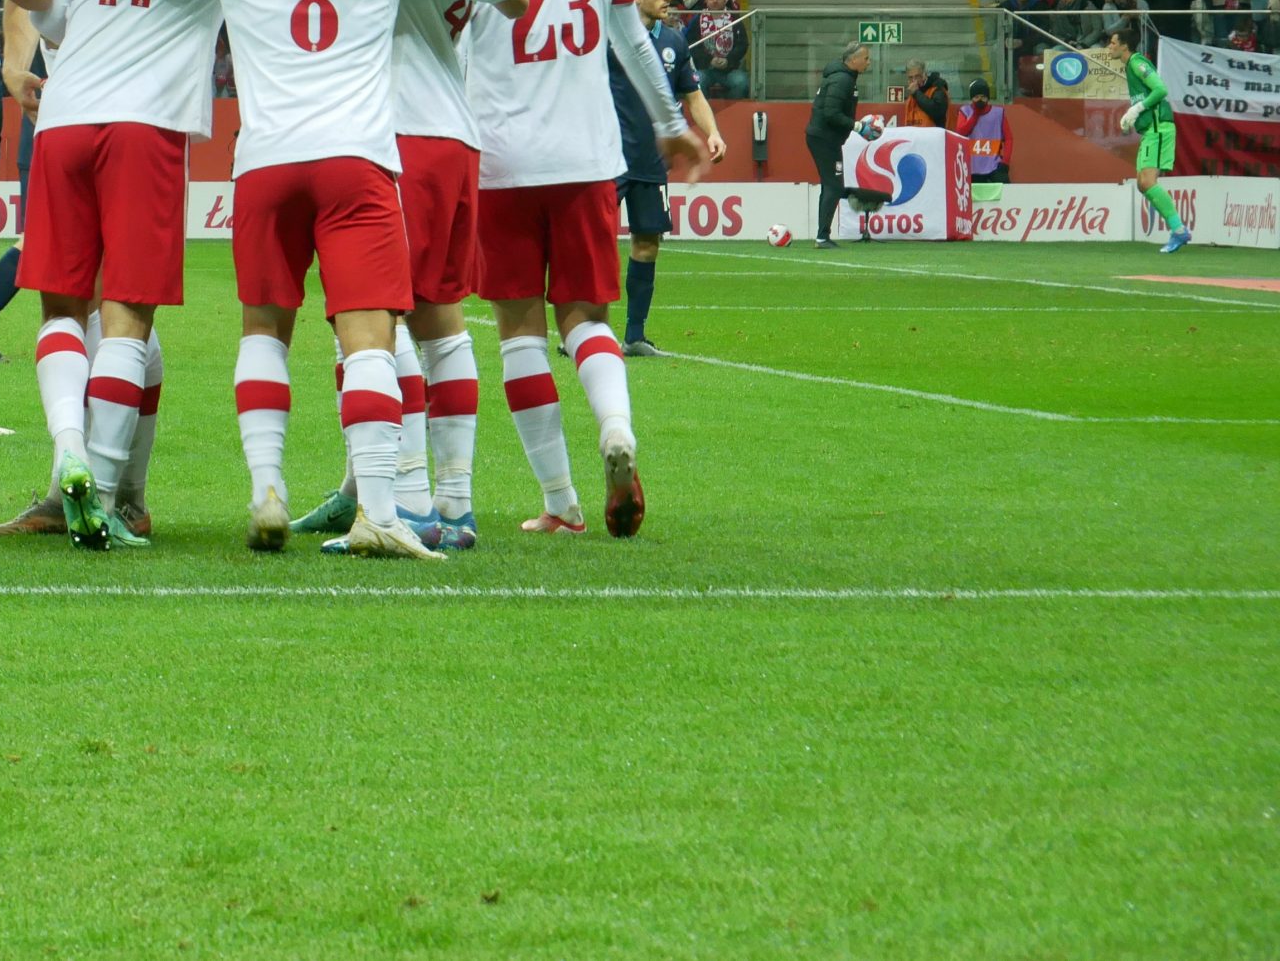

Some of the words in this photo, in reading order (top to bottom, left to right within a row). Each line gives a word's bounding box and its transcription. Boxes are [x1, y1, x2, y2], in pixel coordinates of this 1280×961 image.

[1227, 58, 1272, 76] taką
[1187, 71, 1230, 90] jaką
[1183, 94, 1248, 113] COVID
[972, 139, 992, 154] 44
[617, 195, 743, 236] TOS
[1020, 195, 1110, 242] piłka
